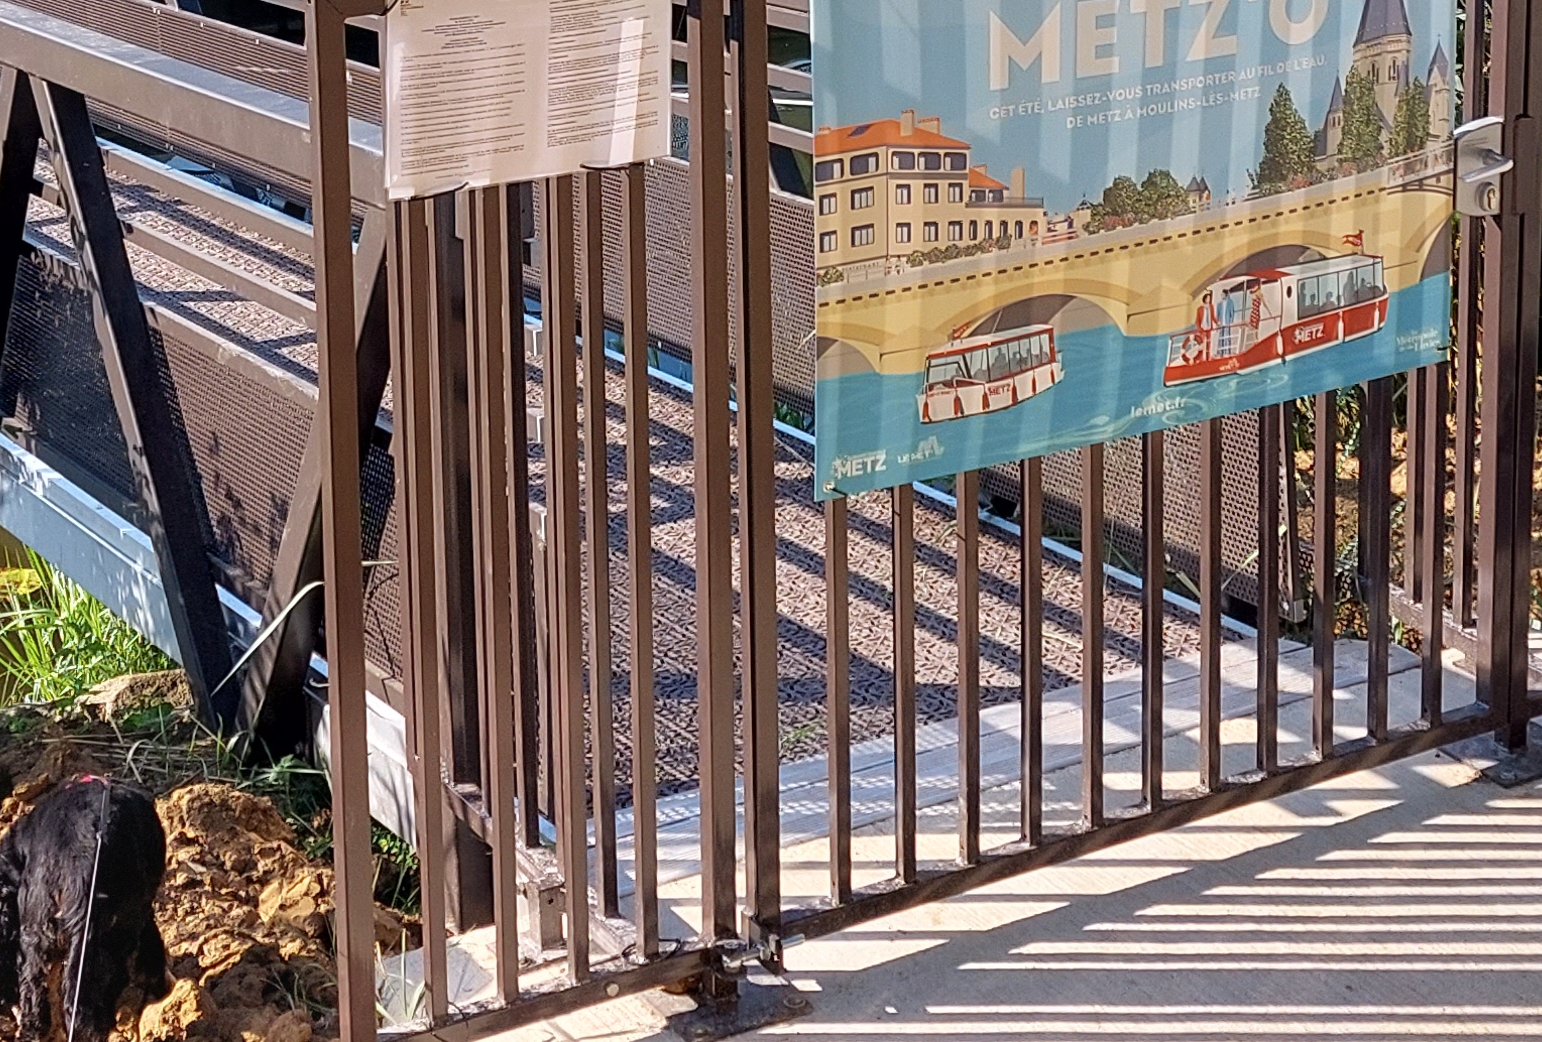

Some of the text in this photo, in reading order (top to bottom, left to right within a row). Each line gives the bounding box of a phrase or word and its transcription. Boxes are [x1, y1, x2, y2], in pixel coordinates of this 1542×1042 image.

[989, 105, 1016, 120] CET
[1018, 97, 1044, 116] ÉTÉ,
[1047, 86, 1143, 111] LAISSEZ-VOUS
[1146, 70, 1237, 97] TRANSPORTER
[1238, 67, 1256, 81] AU
[1258, 63, 1274, 77] FIL
[1276, 60, 1292, 74] DE
[1066, 86, 1262, 129] DE METZ À MOULINS-LÈS-METZ
[837, 455, 887, 479] METZ
